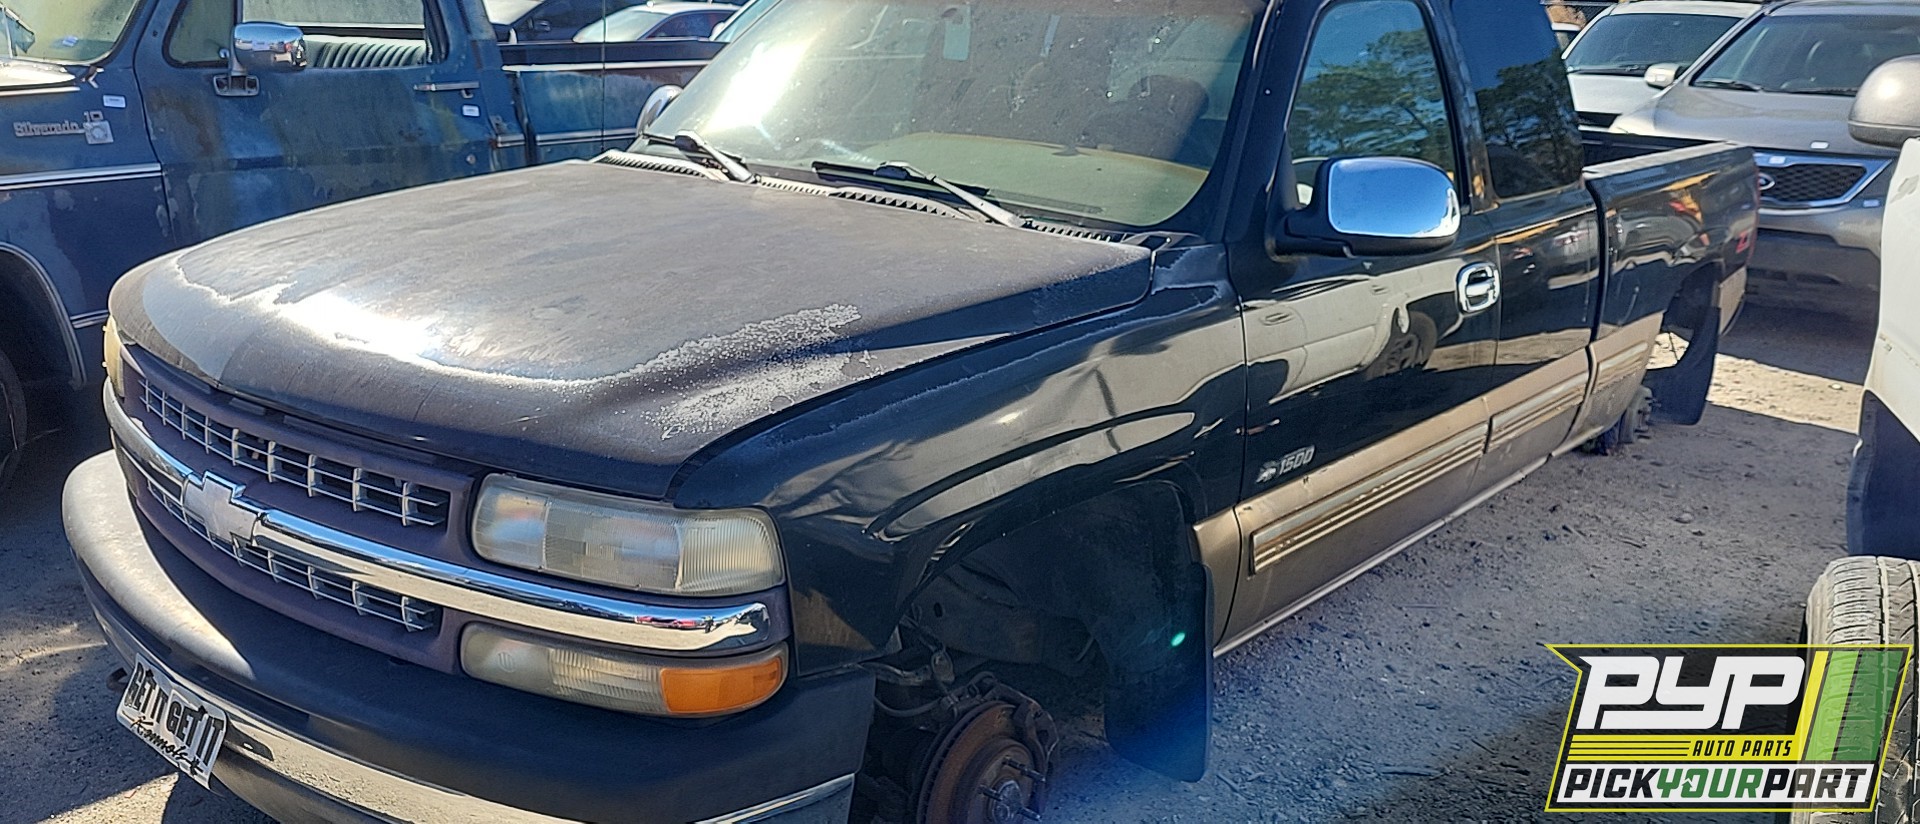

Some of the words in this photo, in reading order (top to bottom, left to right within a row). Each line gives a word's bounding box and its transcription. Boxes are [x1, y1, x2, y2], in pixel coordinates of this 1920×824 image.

[13, 120, 80, 137] Silverado
[1279, 445, 1315, 475] 1500
[166, 701, 204, 748] GET
[196, 714, 224, 766] IT
